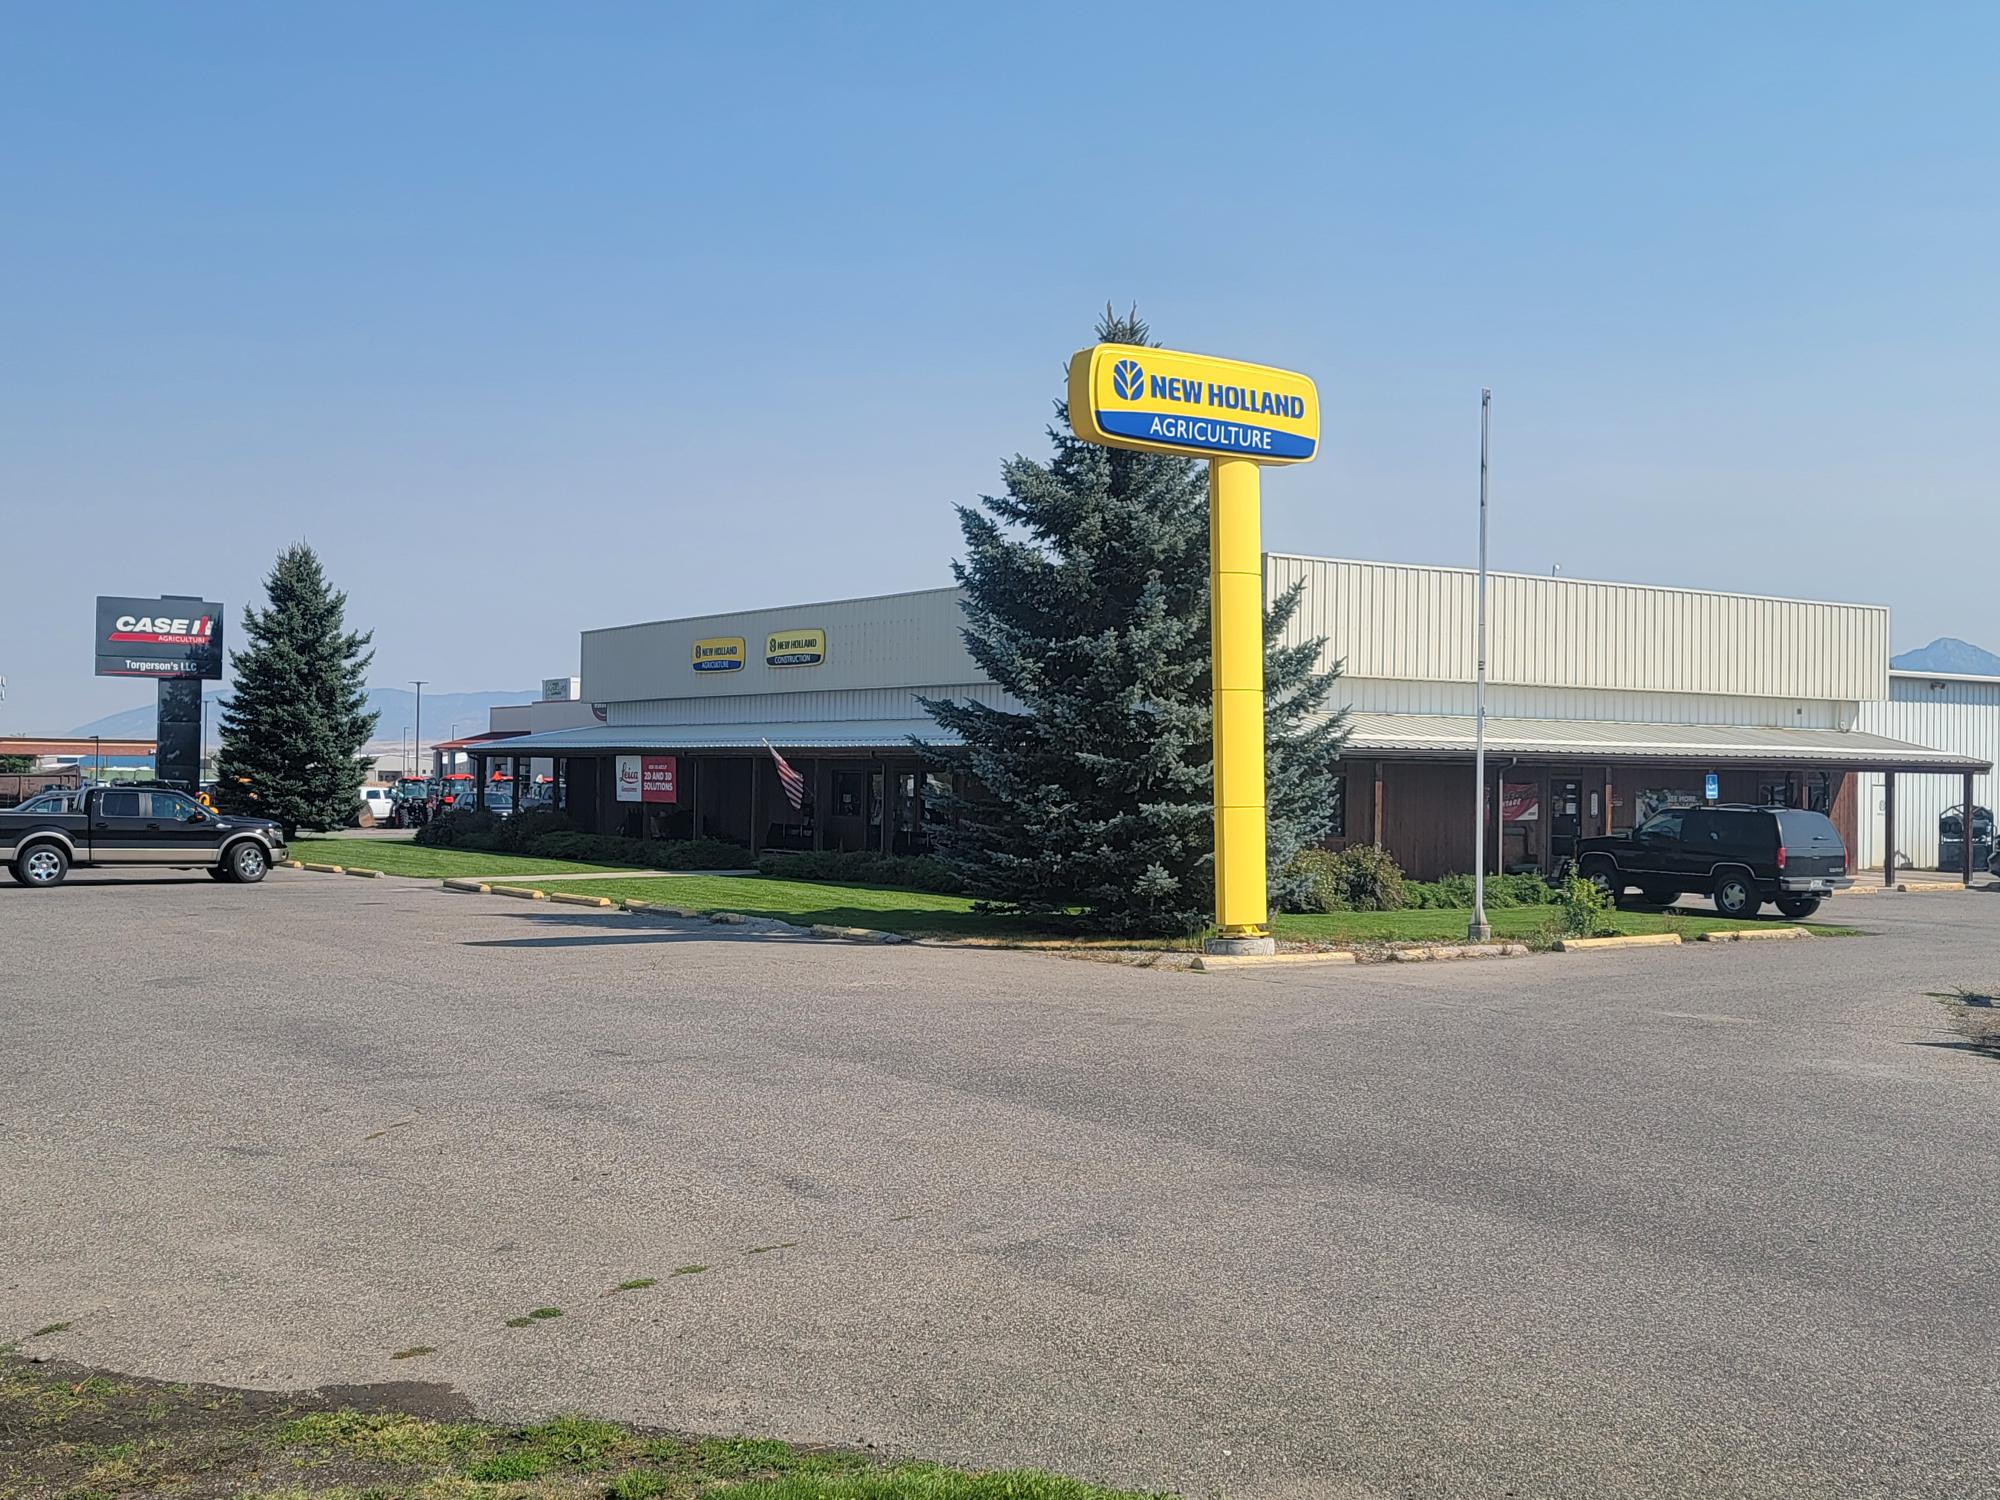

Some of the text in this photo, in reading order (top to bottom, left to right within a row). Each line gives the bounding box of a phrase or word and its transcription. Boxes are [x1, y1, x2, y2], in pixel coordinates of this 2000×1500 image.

[1150, 374, 1305, 419] NEW HOLLAND
[1150, 416, 1272, 450] AGRICULTURE
[115, 616, 189, 634] CASE
[777, 638, 817, 650] NEW HOLLAND
[702, 646, 738, 656] NEW HOLLAND
[774, 654, 811, 665] CONSTRUCTION
[125, 660, 198, 672] Torgerson's LLC
[620, 762, 639, 784] Leica
[644, 772, 652, 780] 2D
[652, 772, 663, 780] AND
[643, 782, 673, 791] SOLUTIONS
